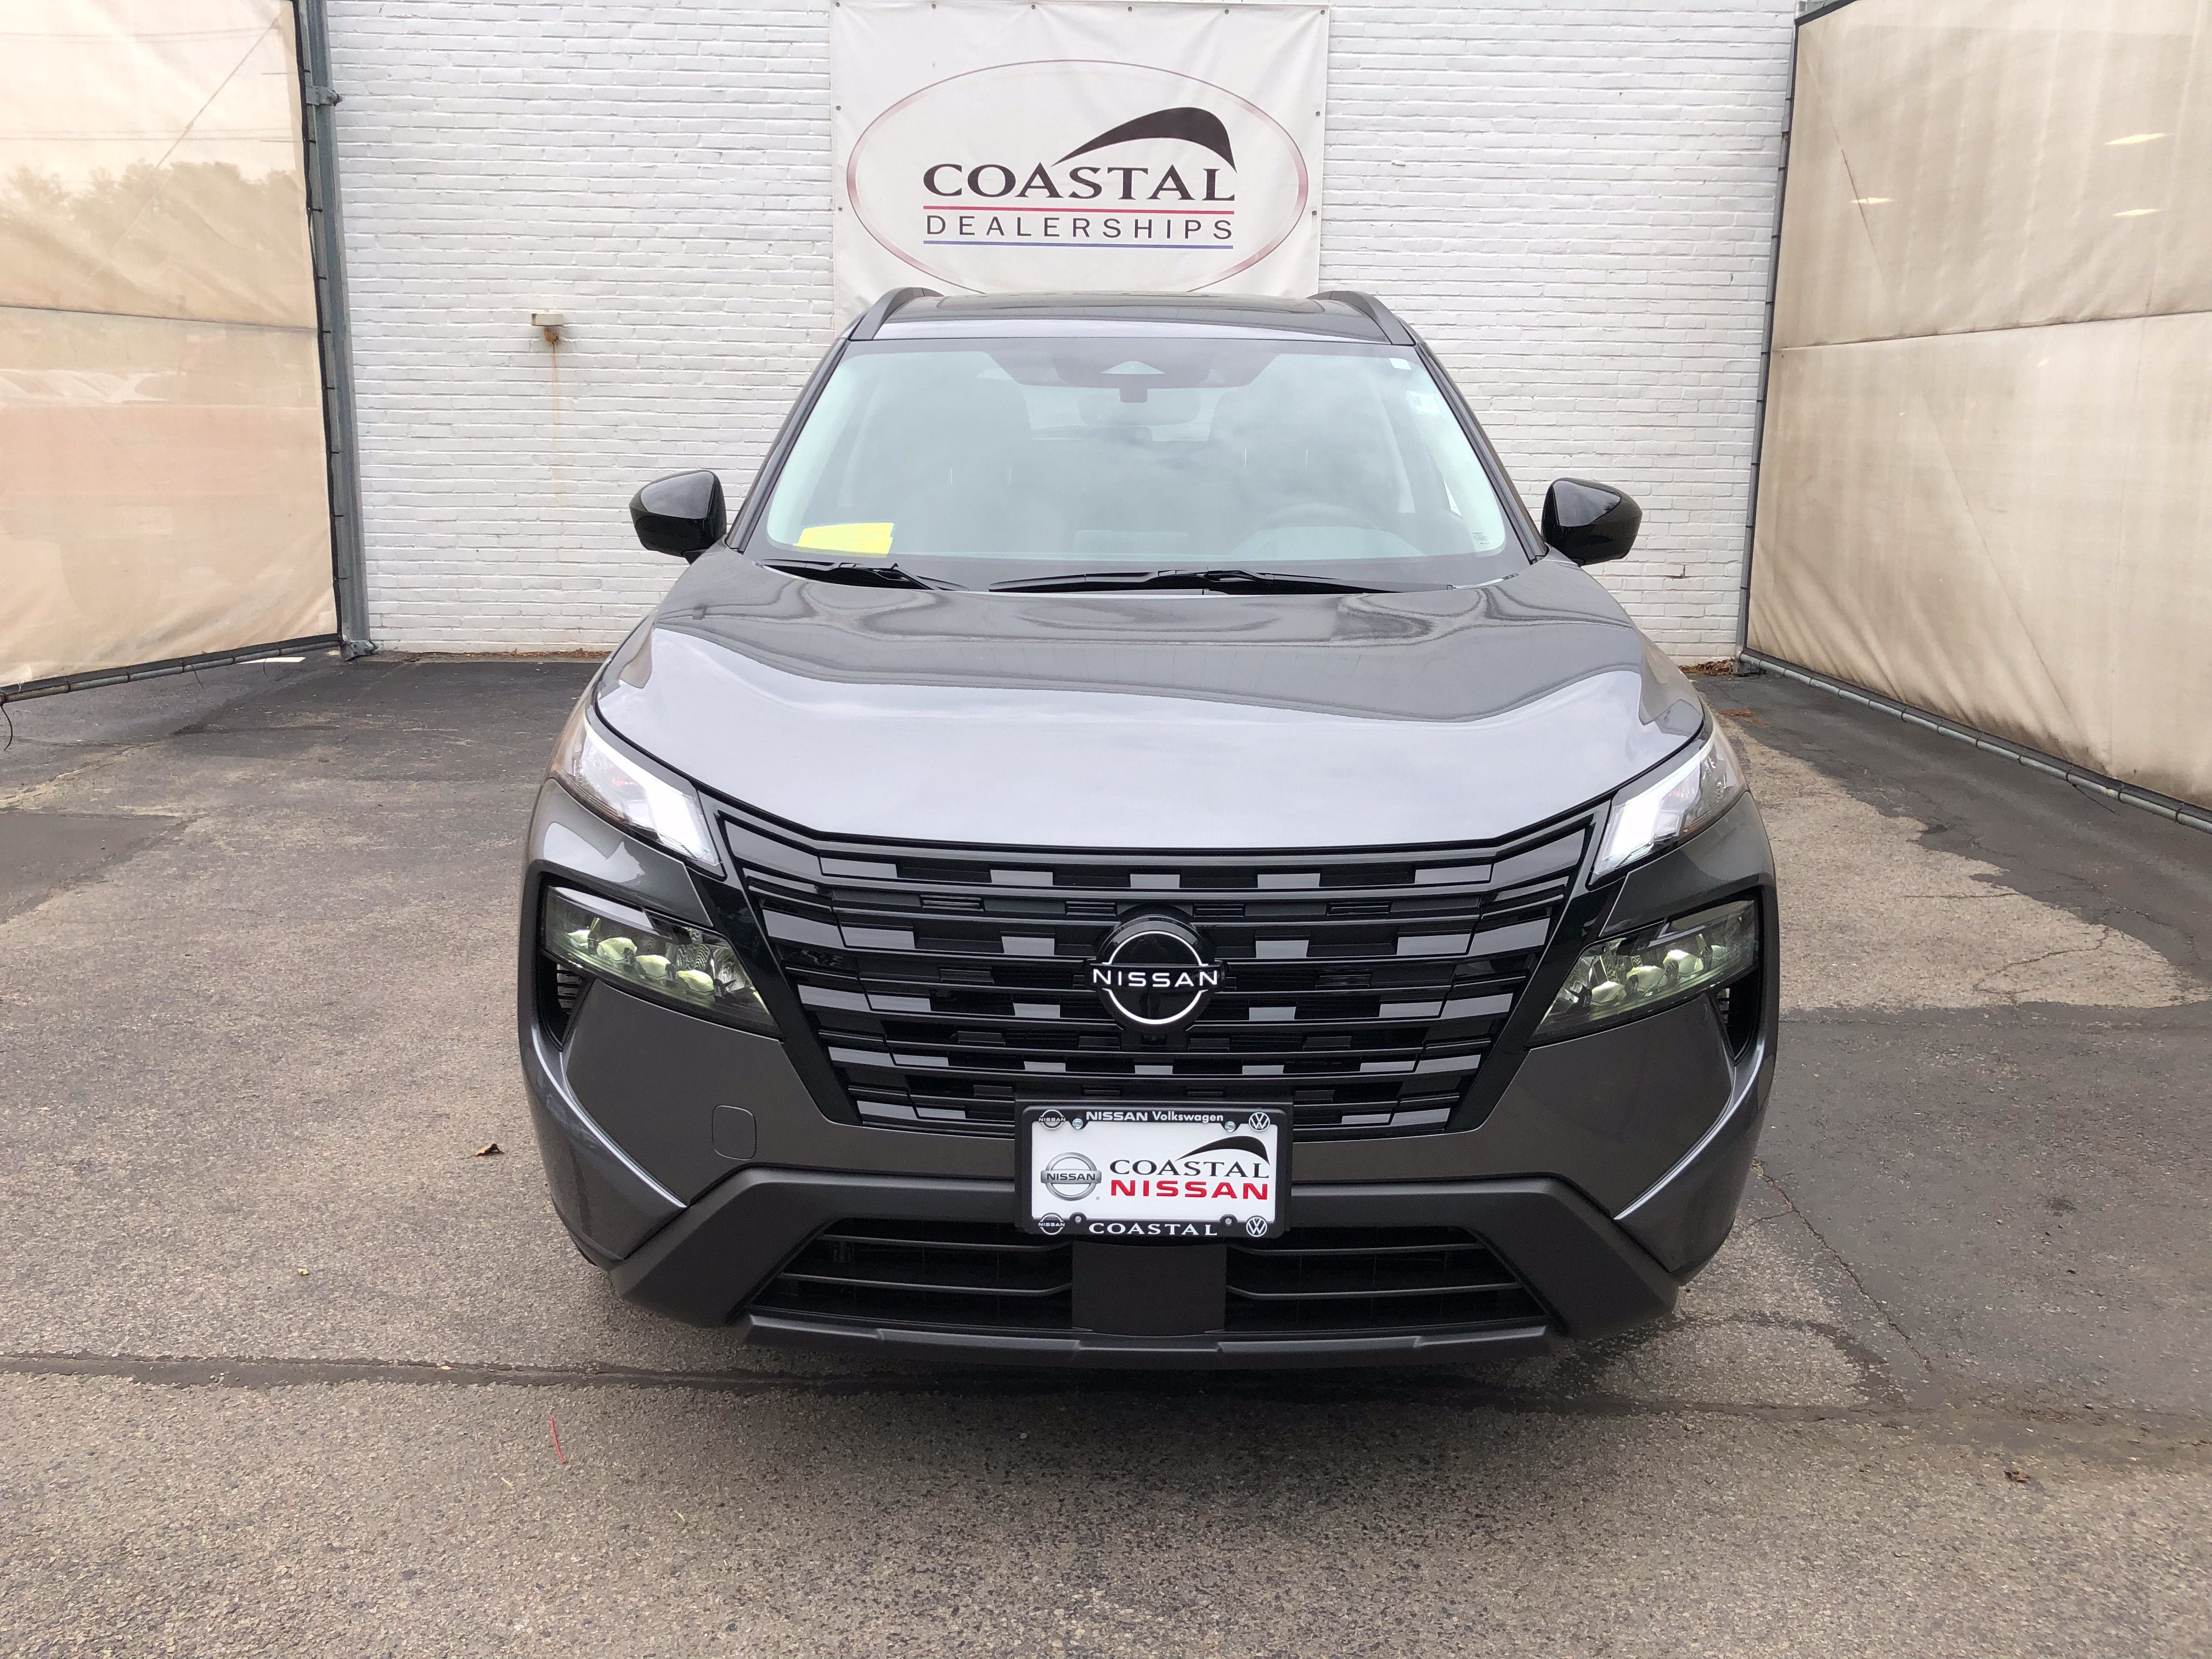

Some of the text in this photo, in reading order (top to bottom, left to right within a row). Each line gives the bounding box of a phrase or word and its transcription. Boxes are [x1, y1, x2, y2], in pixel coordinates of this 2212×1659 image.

[923, 162, 1235, 201] COASTAL
[927, 215, 1233, 240] DEALERSHIPS
[1093, 968, 1218, 988] NISSAN
[1086, 1110, 1224, 1124] NISSAN Volkswagen
[1047, 1172, 1096, 1181] NISSAN
[1109, 1159, 1269, 1178] COASTAL
[1110, 1179, 1268, 1200] NISSAN
[1088, 1222, 1217, 1235] COASTAL
